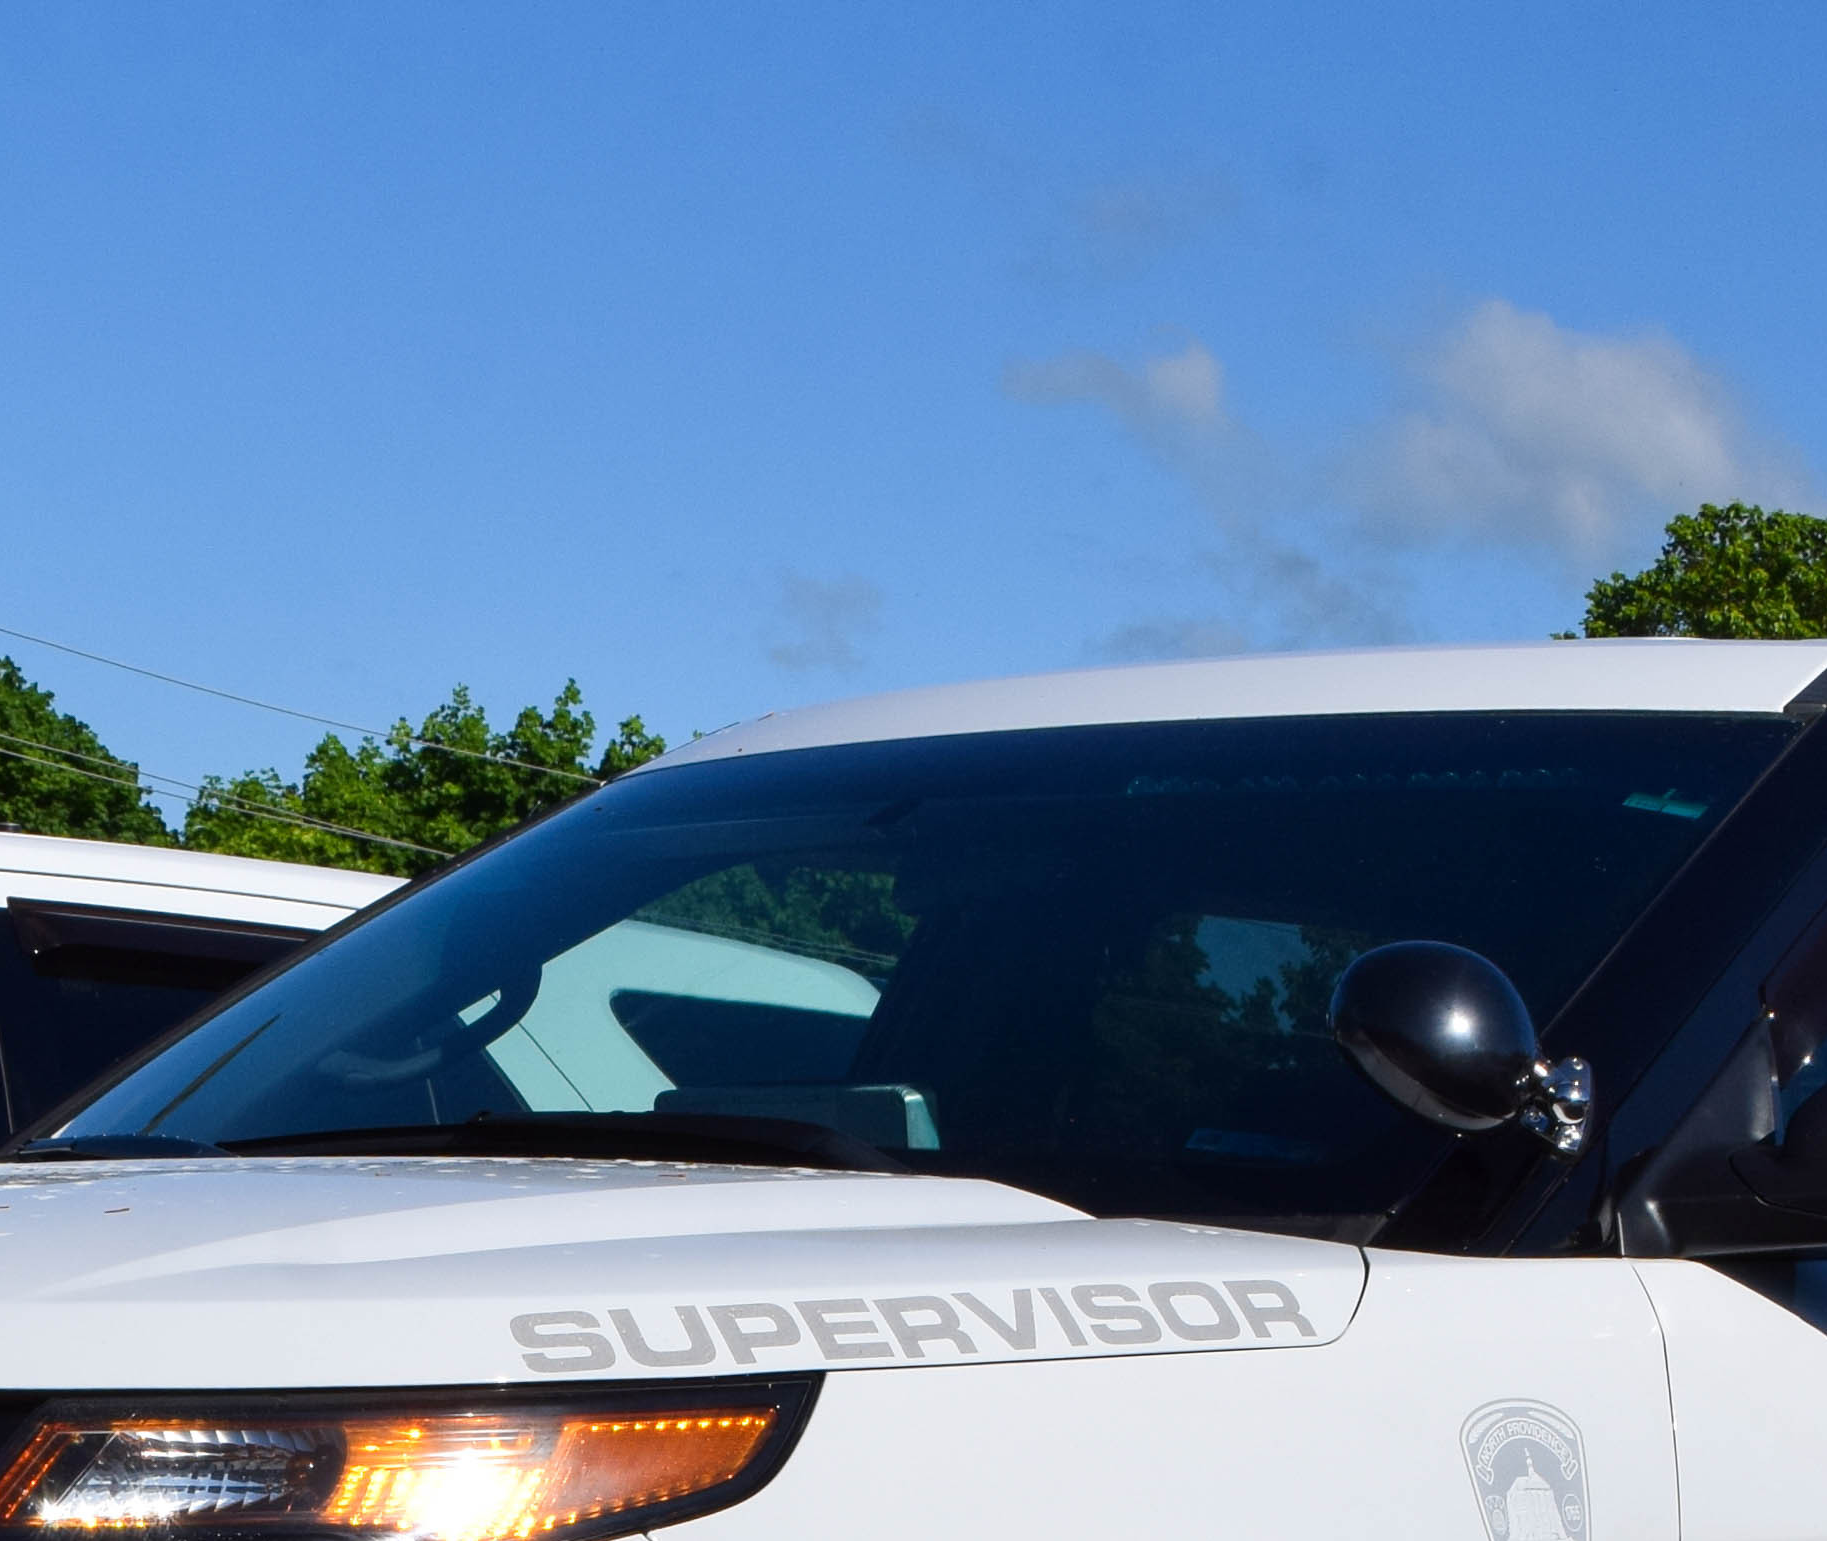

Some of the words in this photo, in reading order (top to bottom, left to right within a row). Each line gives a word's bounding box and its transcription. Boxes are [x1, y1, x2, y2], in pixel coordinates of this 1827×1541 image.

[509, 1279, 1318, 1374] SUPERVISOR
[1480, 1425, 1506, 1466] NORTH
[1506, 1421, 1571, 1464] PROVIDENCE
